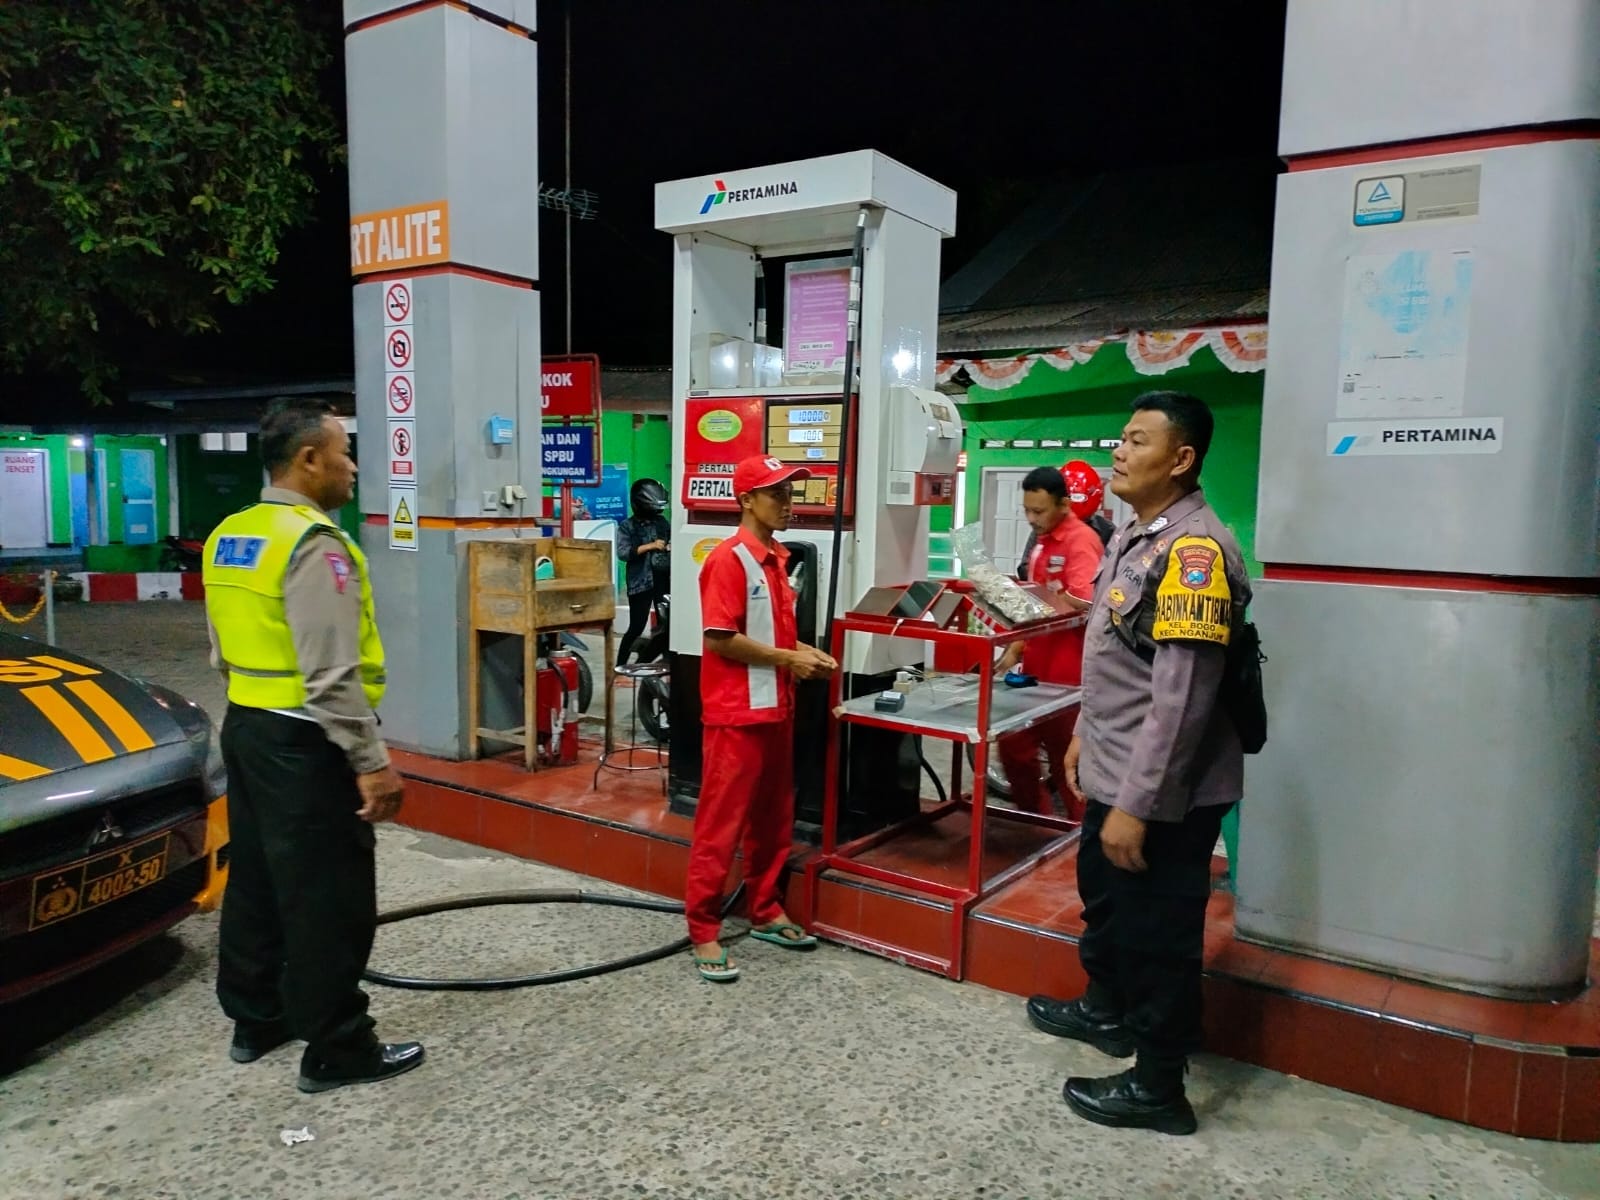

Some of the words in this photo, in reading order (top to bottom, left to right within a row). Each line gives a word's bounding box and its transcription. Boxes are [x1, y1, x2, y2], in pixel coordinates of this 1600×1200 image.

[728, 181, 798, 203] PERTAMINA
[541, 372, 573, 387] KOK
[557, 433, 580, 445] DAN
[1382, 427, 1497, 443] PERTAMINA
[4, 456, 36, 464] RUANG
[544, 450, 574, 462] SPBU
[691, 480, 733, 497] PERTAL
[1180, 629, 1224, 640] NGANJUK
[118, 850, 134, 868] X
[88, 858, 161, 903] 4002-50
